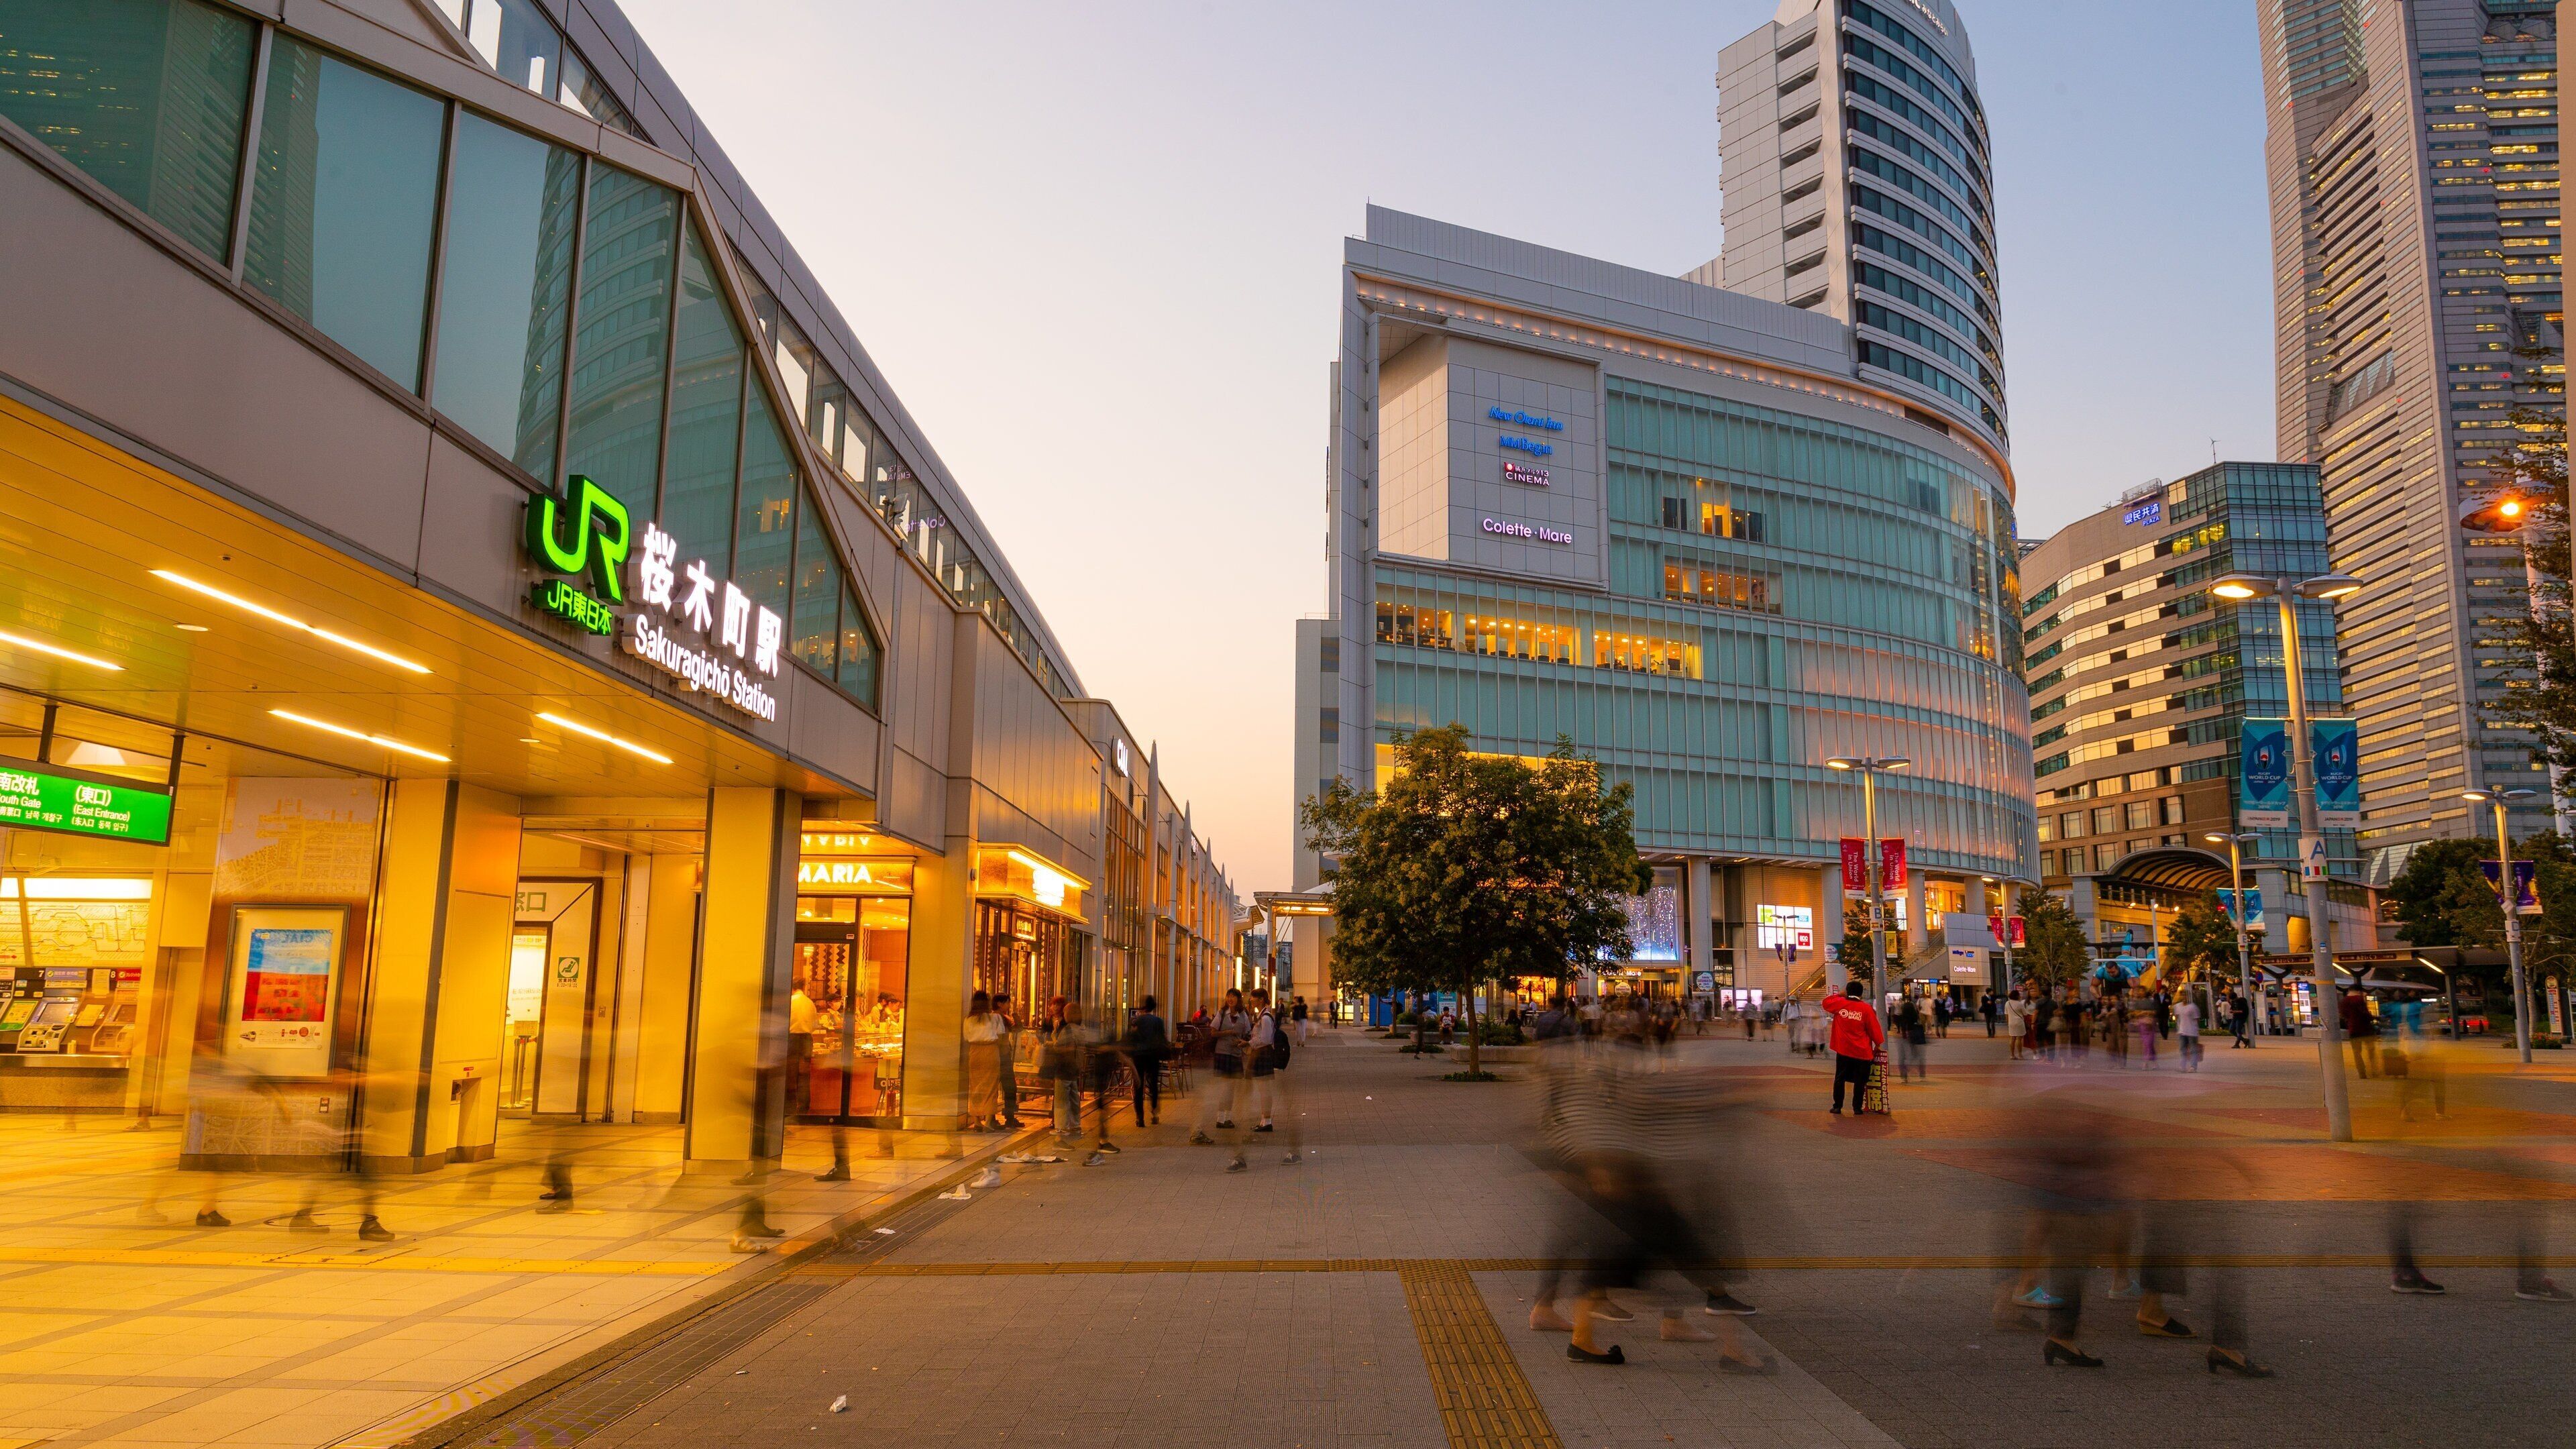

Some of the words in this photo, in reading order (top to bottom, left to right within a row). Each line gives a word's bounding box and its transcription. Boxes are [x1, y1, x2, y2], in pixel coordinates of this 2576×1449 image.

[1489, 406, 1512, 421] New
[1505, 472, 1550, 486] CINEMA
[2142, 516, 2159, 526] PLAZA
[539, 475, 631, 603] JR
[547, 581, 612, 635] JR東日本
[641, 521, 782, 678] 桜木町駅
[635, 613, 731, 698] Sakuragichō
[733, 669, 776, 722] Station
[0, 793, 19, 805] outh
[21, 796, 42, 808] Gate
[2310, 840, 2327, 860] A
[1874, 908, 1882, 919] B
